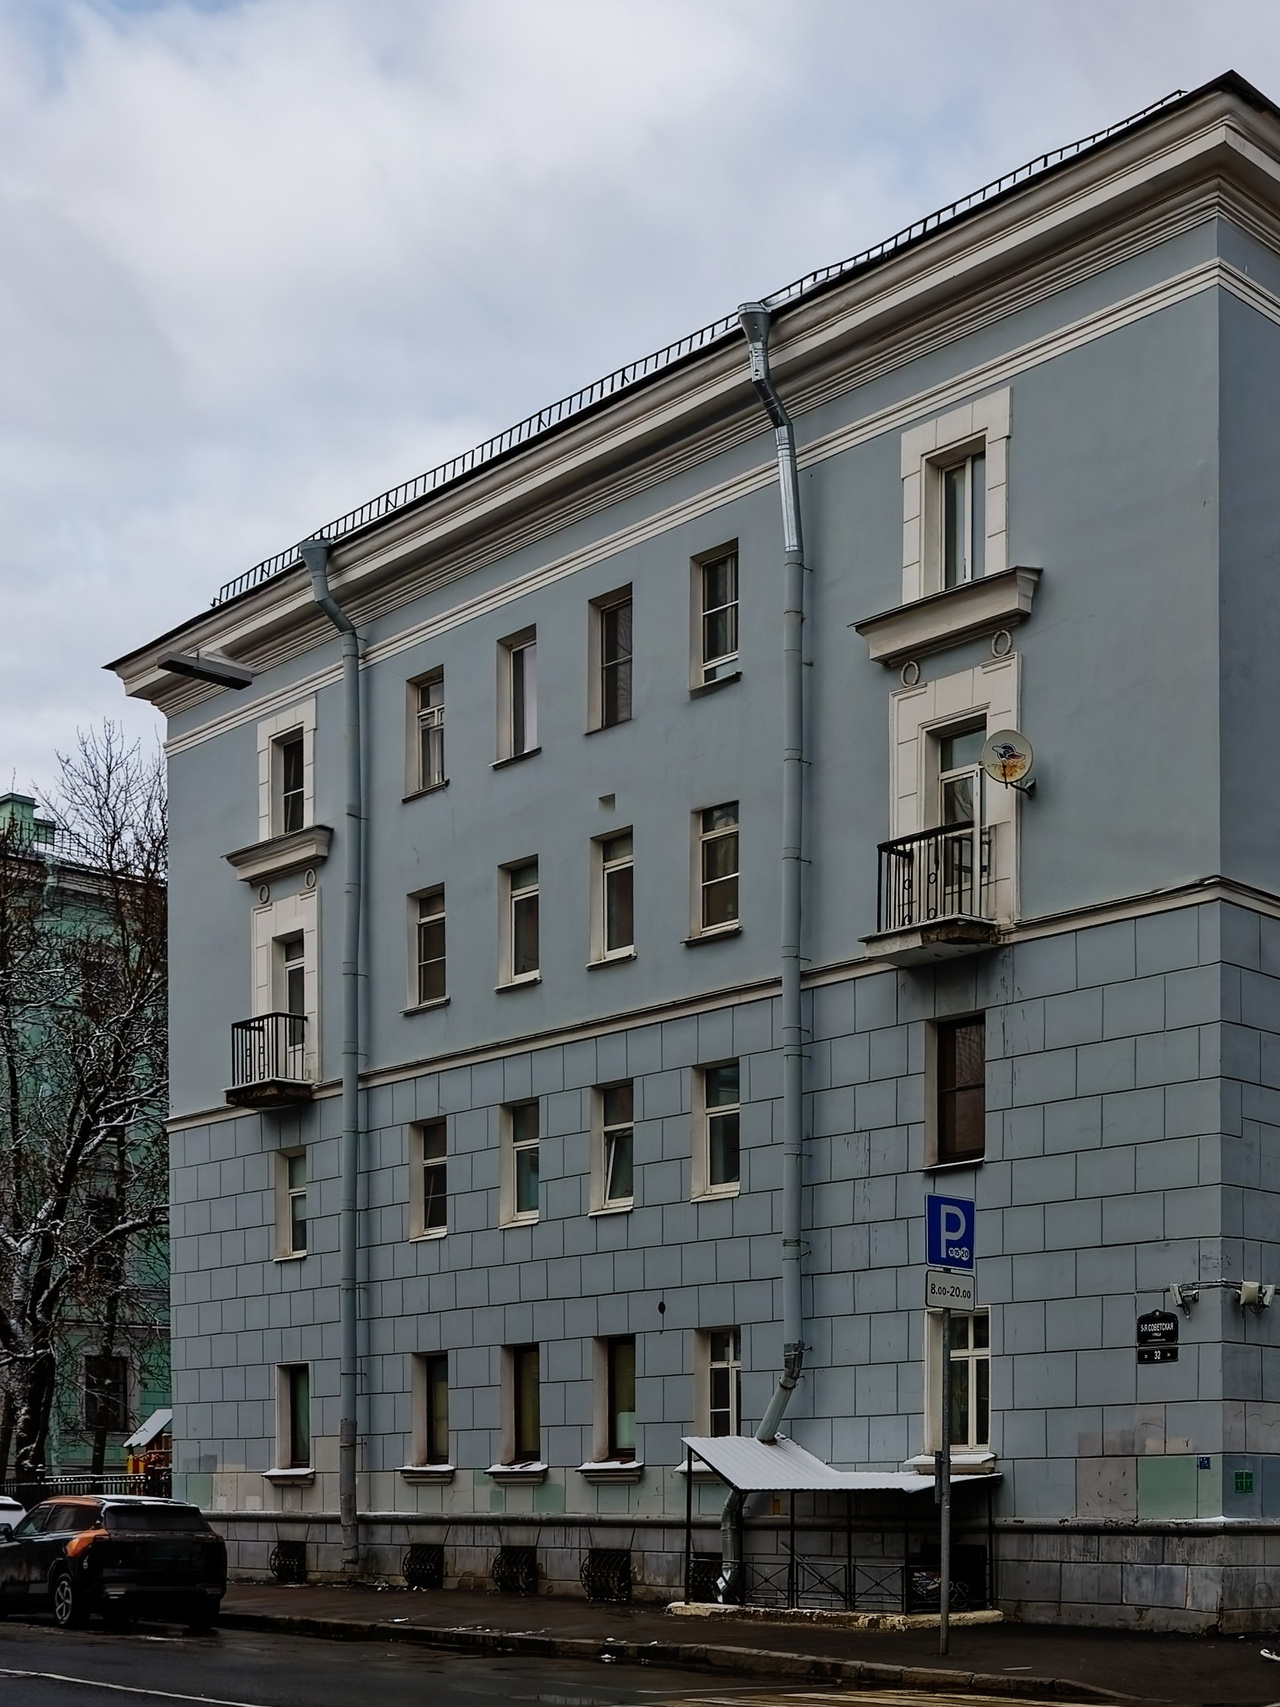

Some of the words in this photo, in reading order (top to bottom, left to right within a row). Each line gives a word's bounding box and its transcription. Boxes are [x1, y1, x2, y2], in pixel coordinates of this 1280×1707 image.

[941, 1204, 966, 1258] P
[930, 1283, 971, 1299] 8.00-20.00
[1148, 1322, 1174, 1332] СОВЕТСКАЯ
[1154, 1350, 1161, 1360] 32
